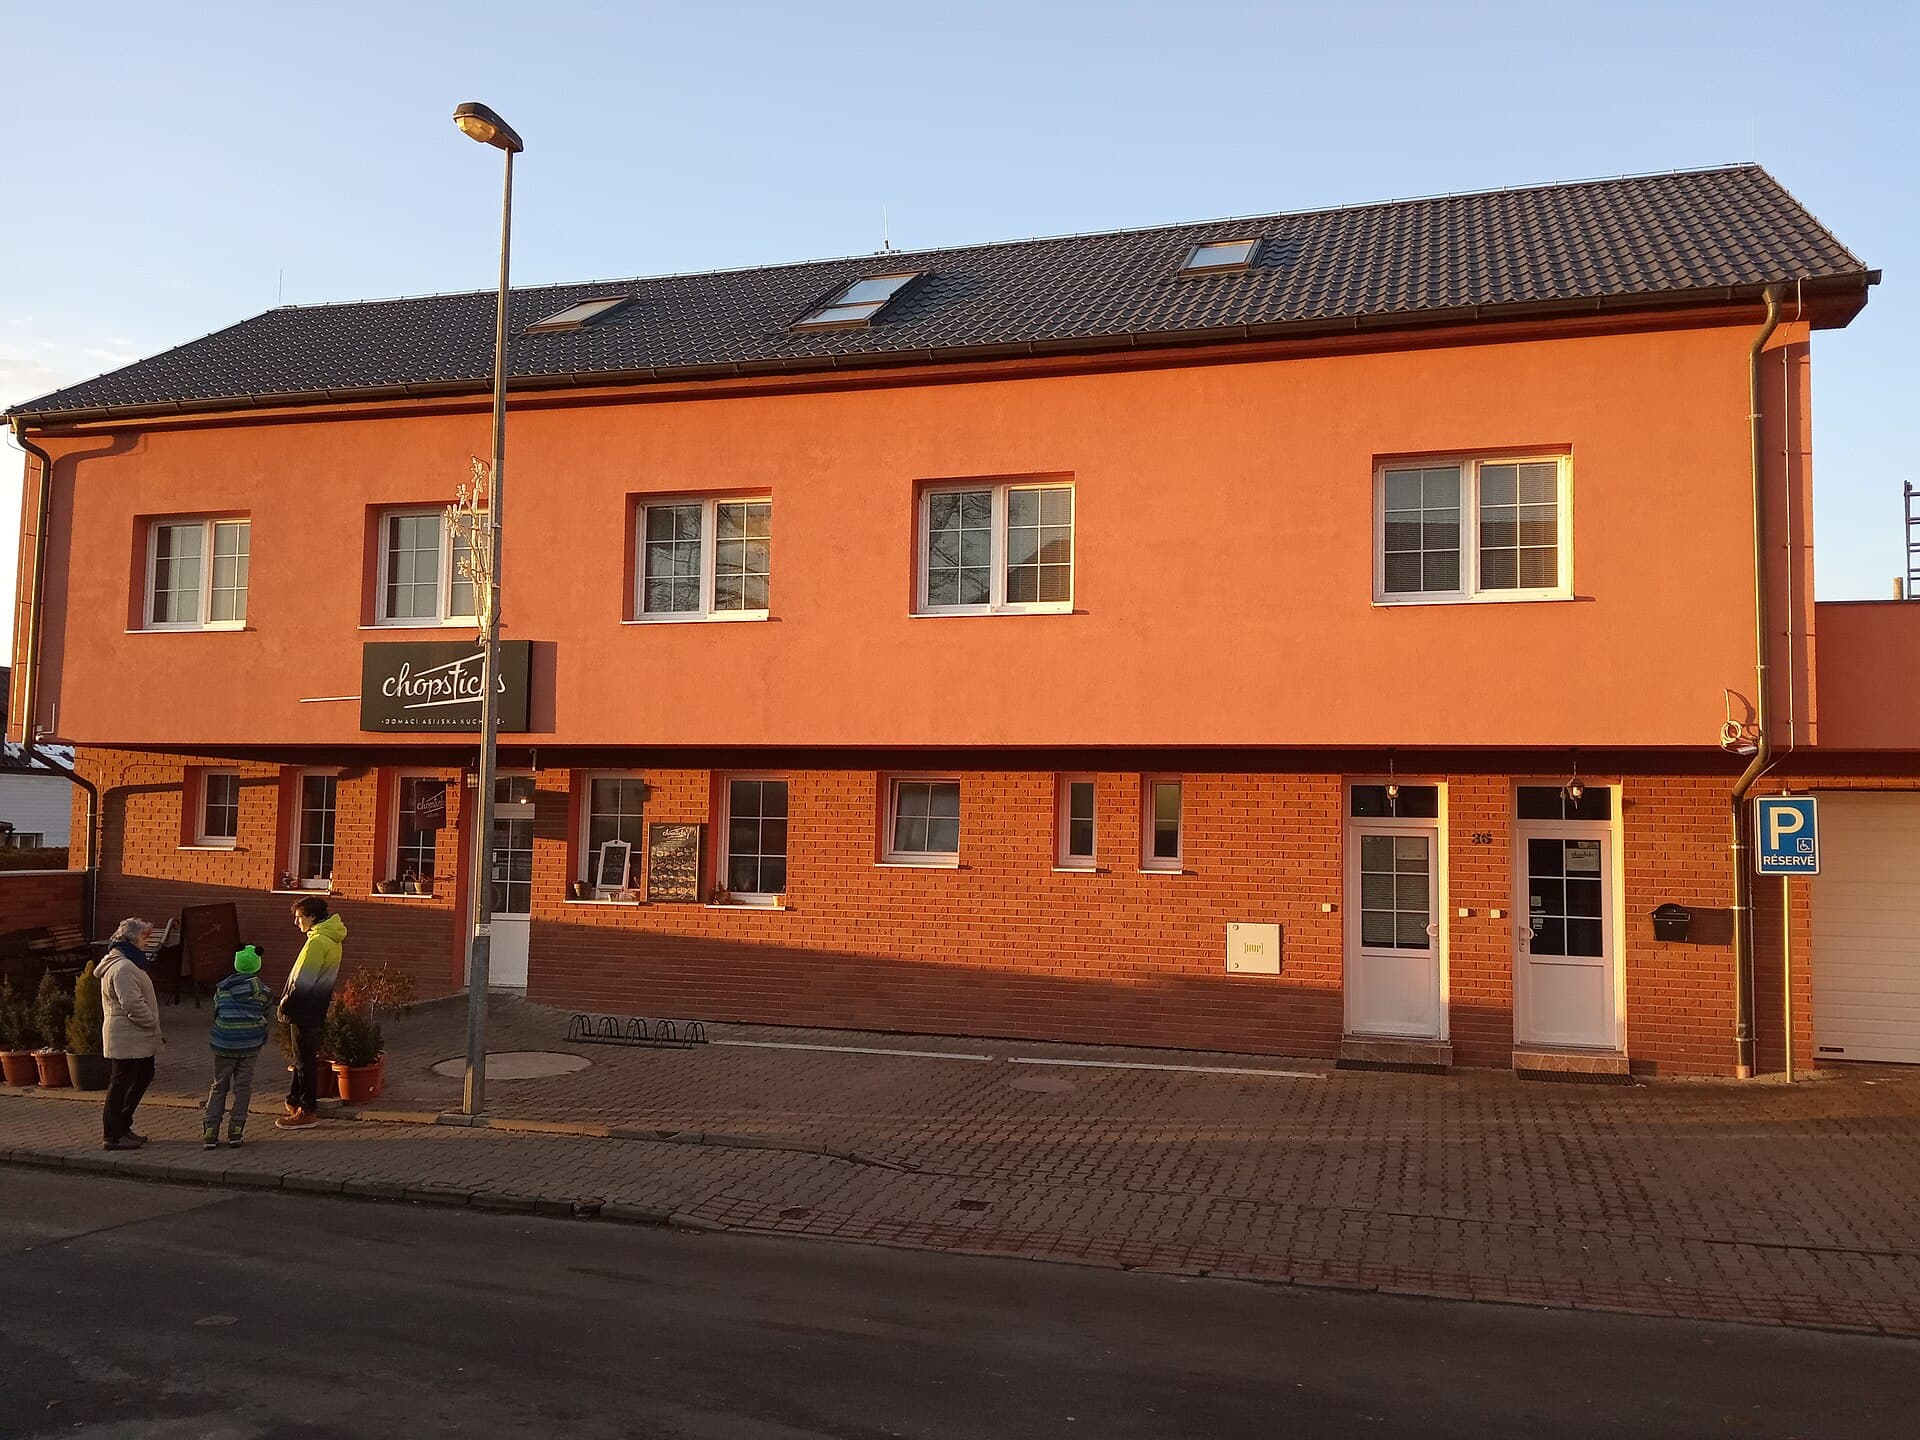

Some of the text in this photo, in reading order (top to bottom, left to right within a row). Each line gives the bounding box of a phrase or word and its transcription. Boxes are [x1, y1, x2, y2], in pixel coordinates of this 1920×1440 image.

[382, 662, 506, 704] chopstics
[1769, 807, 1804, 850] P
[1763, 853, 1815, 866] RÉSERVÉ
